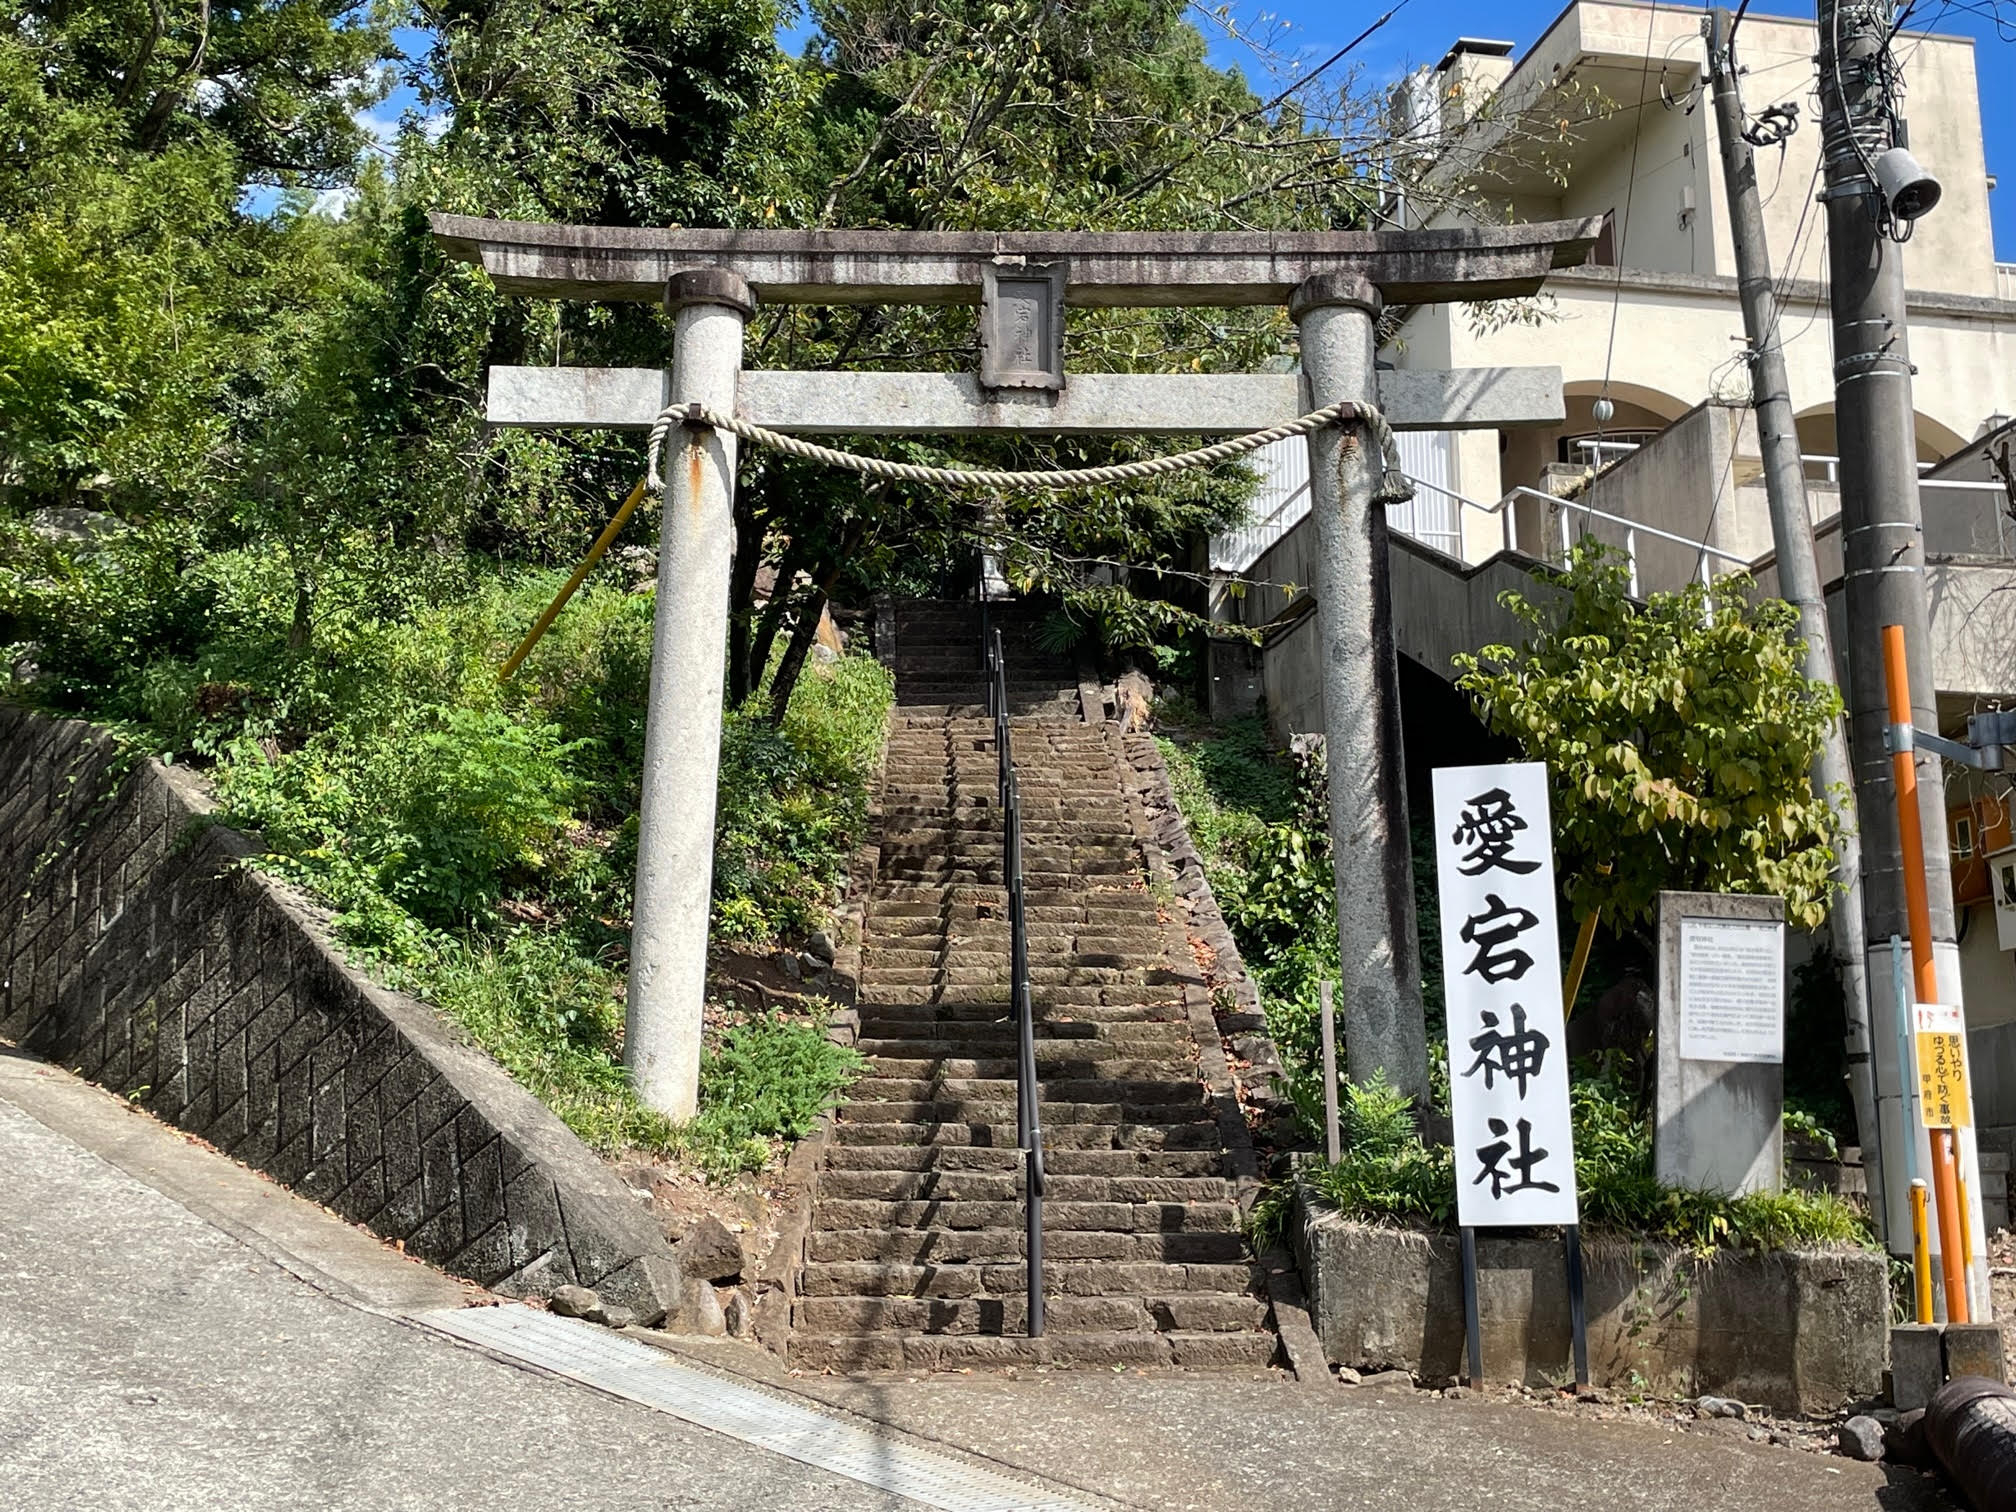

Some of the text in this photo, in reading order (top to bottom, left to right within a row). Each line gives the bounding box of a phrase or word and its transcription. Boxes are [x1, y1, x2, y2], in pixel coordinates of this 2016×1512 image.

[1452, 787, 1560, 1200] 愛宕神社
[1948, 1035, 1962, 1082] 思いやり
